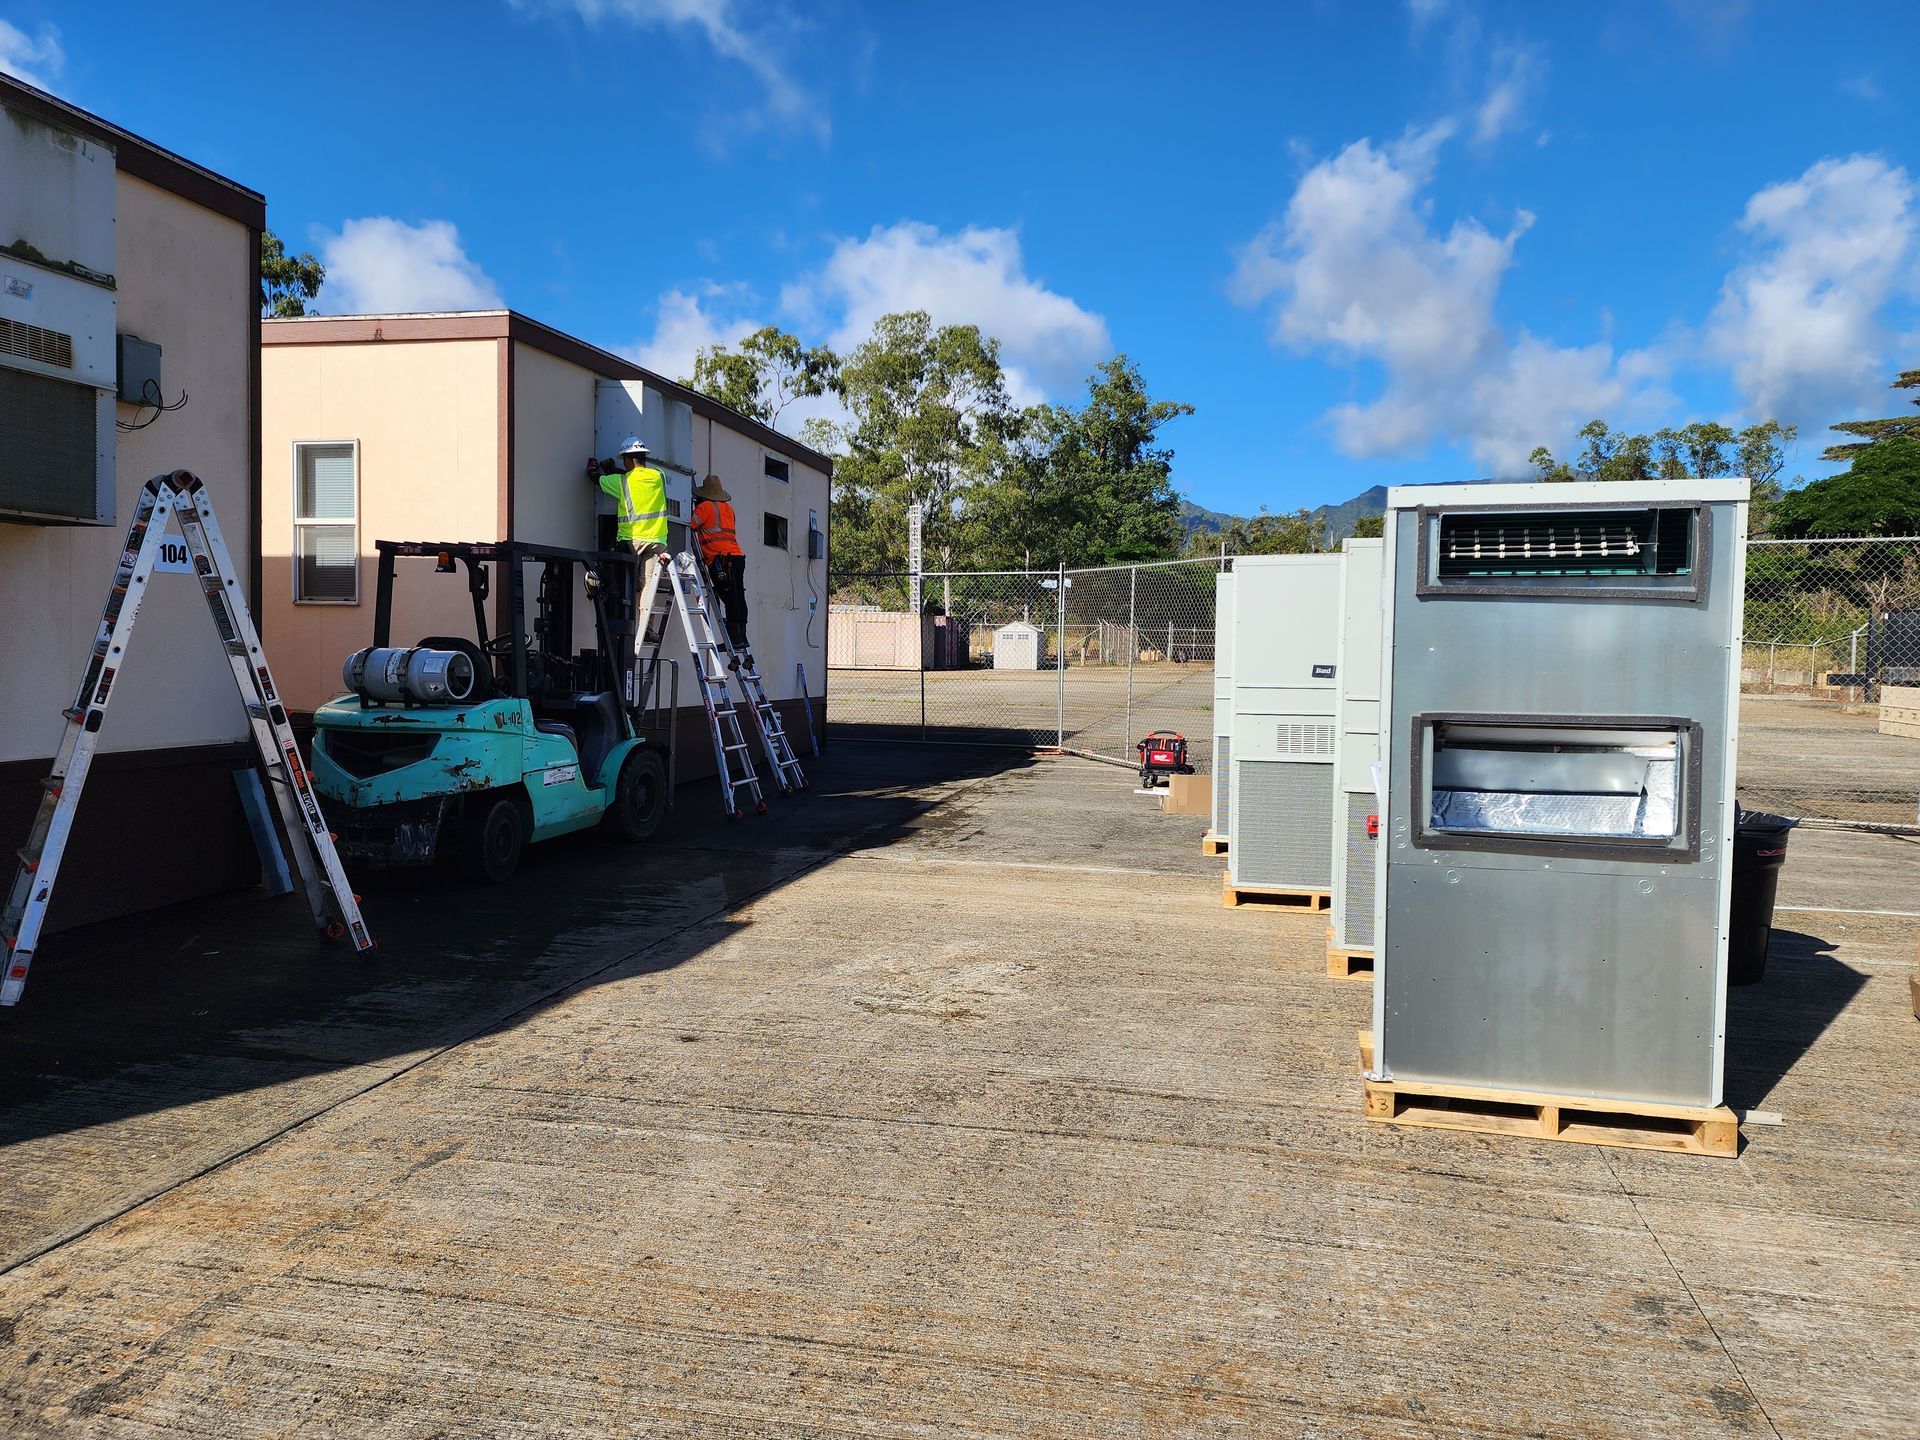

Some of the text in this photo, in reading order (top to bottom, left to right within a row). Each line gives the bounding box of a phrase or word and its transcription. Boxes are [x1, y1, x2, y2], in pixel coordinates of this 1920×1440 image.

[160, 543, 187, 564] 104
[288, 752, 299, 770] Little
[295, 770, 306, 788] Giant
[1376, 1098, 1389, 1111] 3
